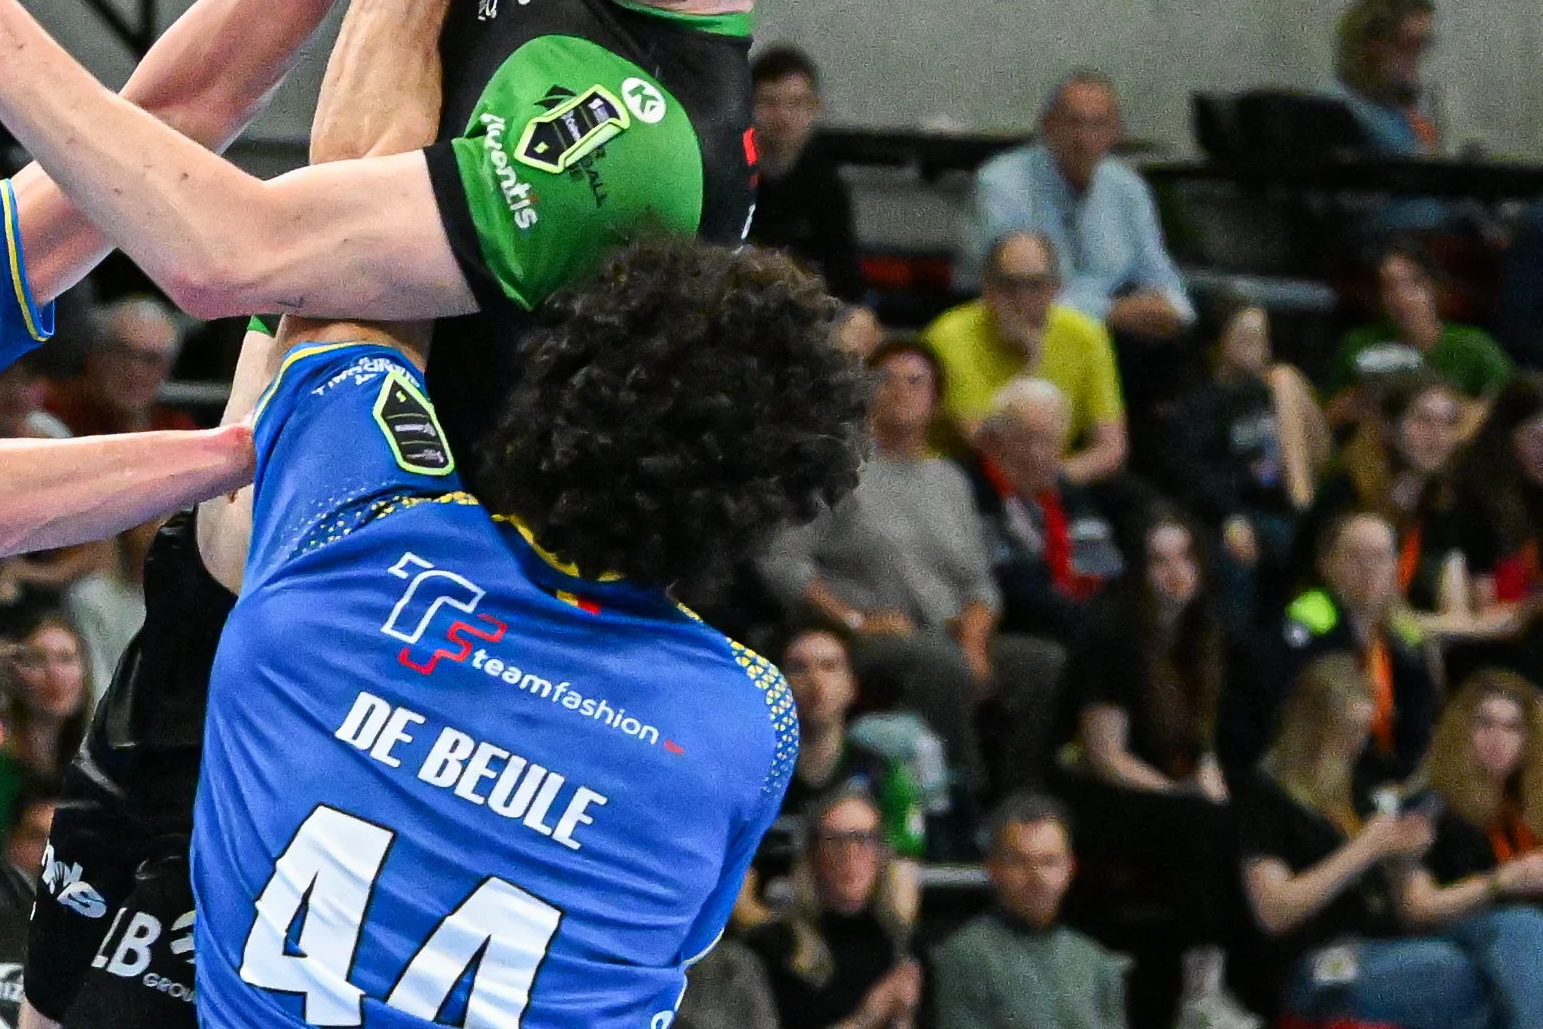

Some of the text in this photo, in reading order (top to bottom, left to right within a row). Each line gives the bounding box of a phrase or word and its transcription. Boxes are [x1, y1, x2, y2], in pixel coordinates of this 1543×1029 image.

[472, 648, 660, 746] teamfashion
[333, 690, 608, 850] DE BEULE
[240, 803, 565, 1029] 44
[143, 971, 196, 1004] GROU
